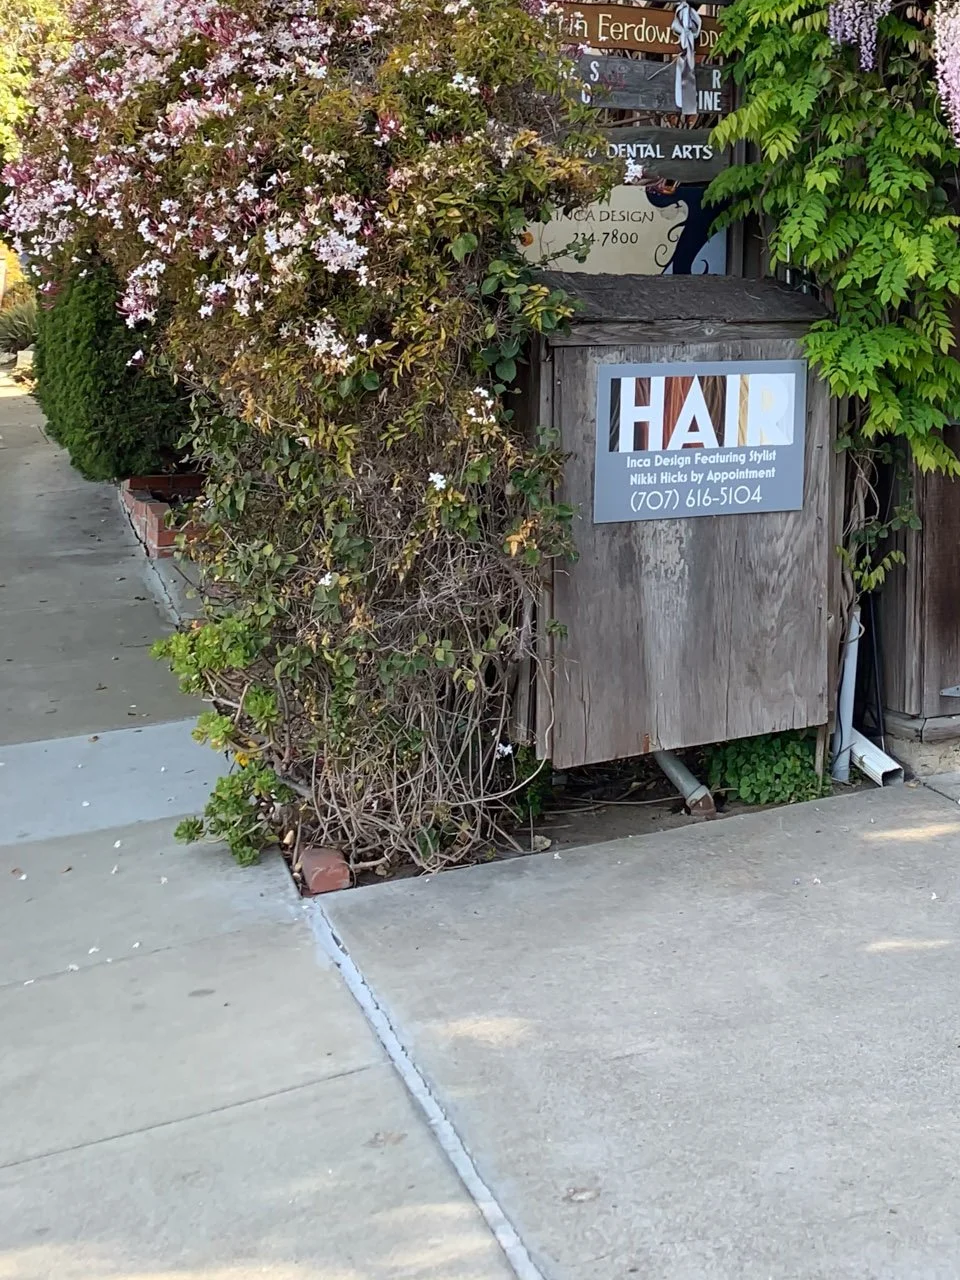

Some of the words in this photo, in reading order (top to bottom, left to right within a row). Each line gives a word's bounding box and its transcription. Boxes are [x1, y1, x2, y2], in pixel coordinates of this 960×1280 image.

[699, 30, 724, 48] DD
[696, 91, 722, 112] INE
[606, 143, 665, 159] DENTAL
[671, 144, 714, 160] ARTS
[600, 210, 655, 224] DESIGN
[618, 373, 794, 453] HAIR
[626, 456, 651, 468] Inca
[654, 454, 691, 469] Design
[694, 451, 746, 465] Featuring
[749, 450, 776, 464] Stylist
[630, 472, 657, 486] Nikki
[660, 471, 688, 484] Hicks
[690, 469, 704, 485] by
[706, 467, 776, 483] Appointment
[630, 488, 680, 513] (707)
[685, 484, 763, 508] 616-5104
